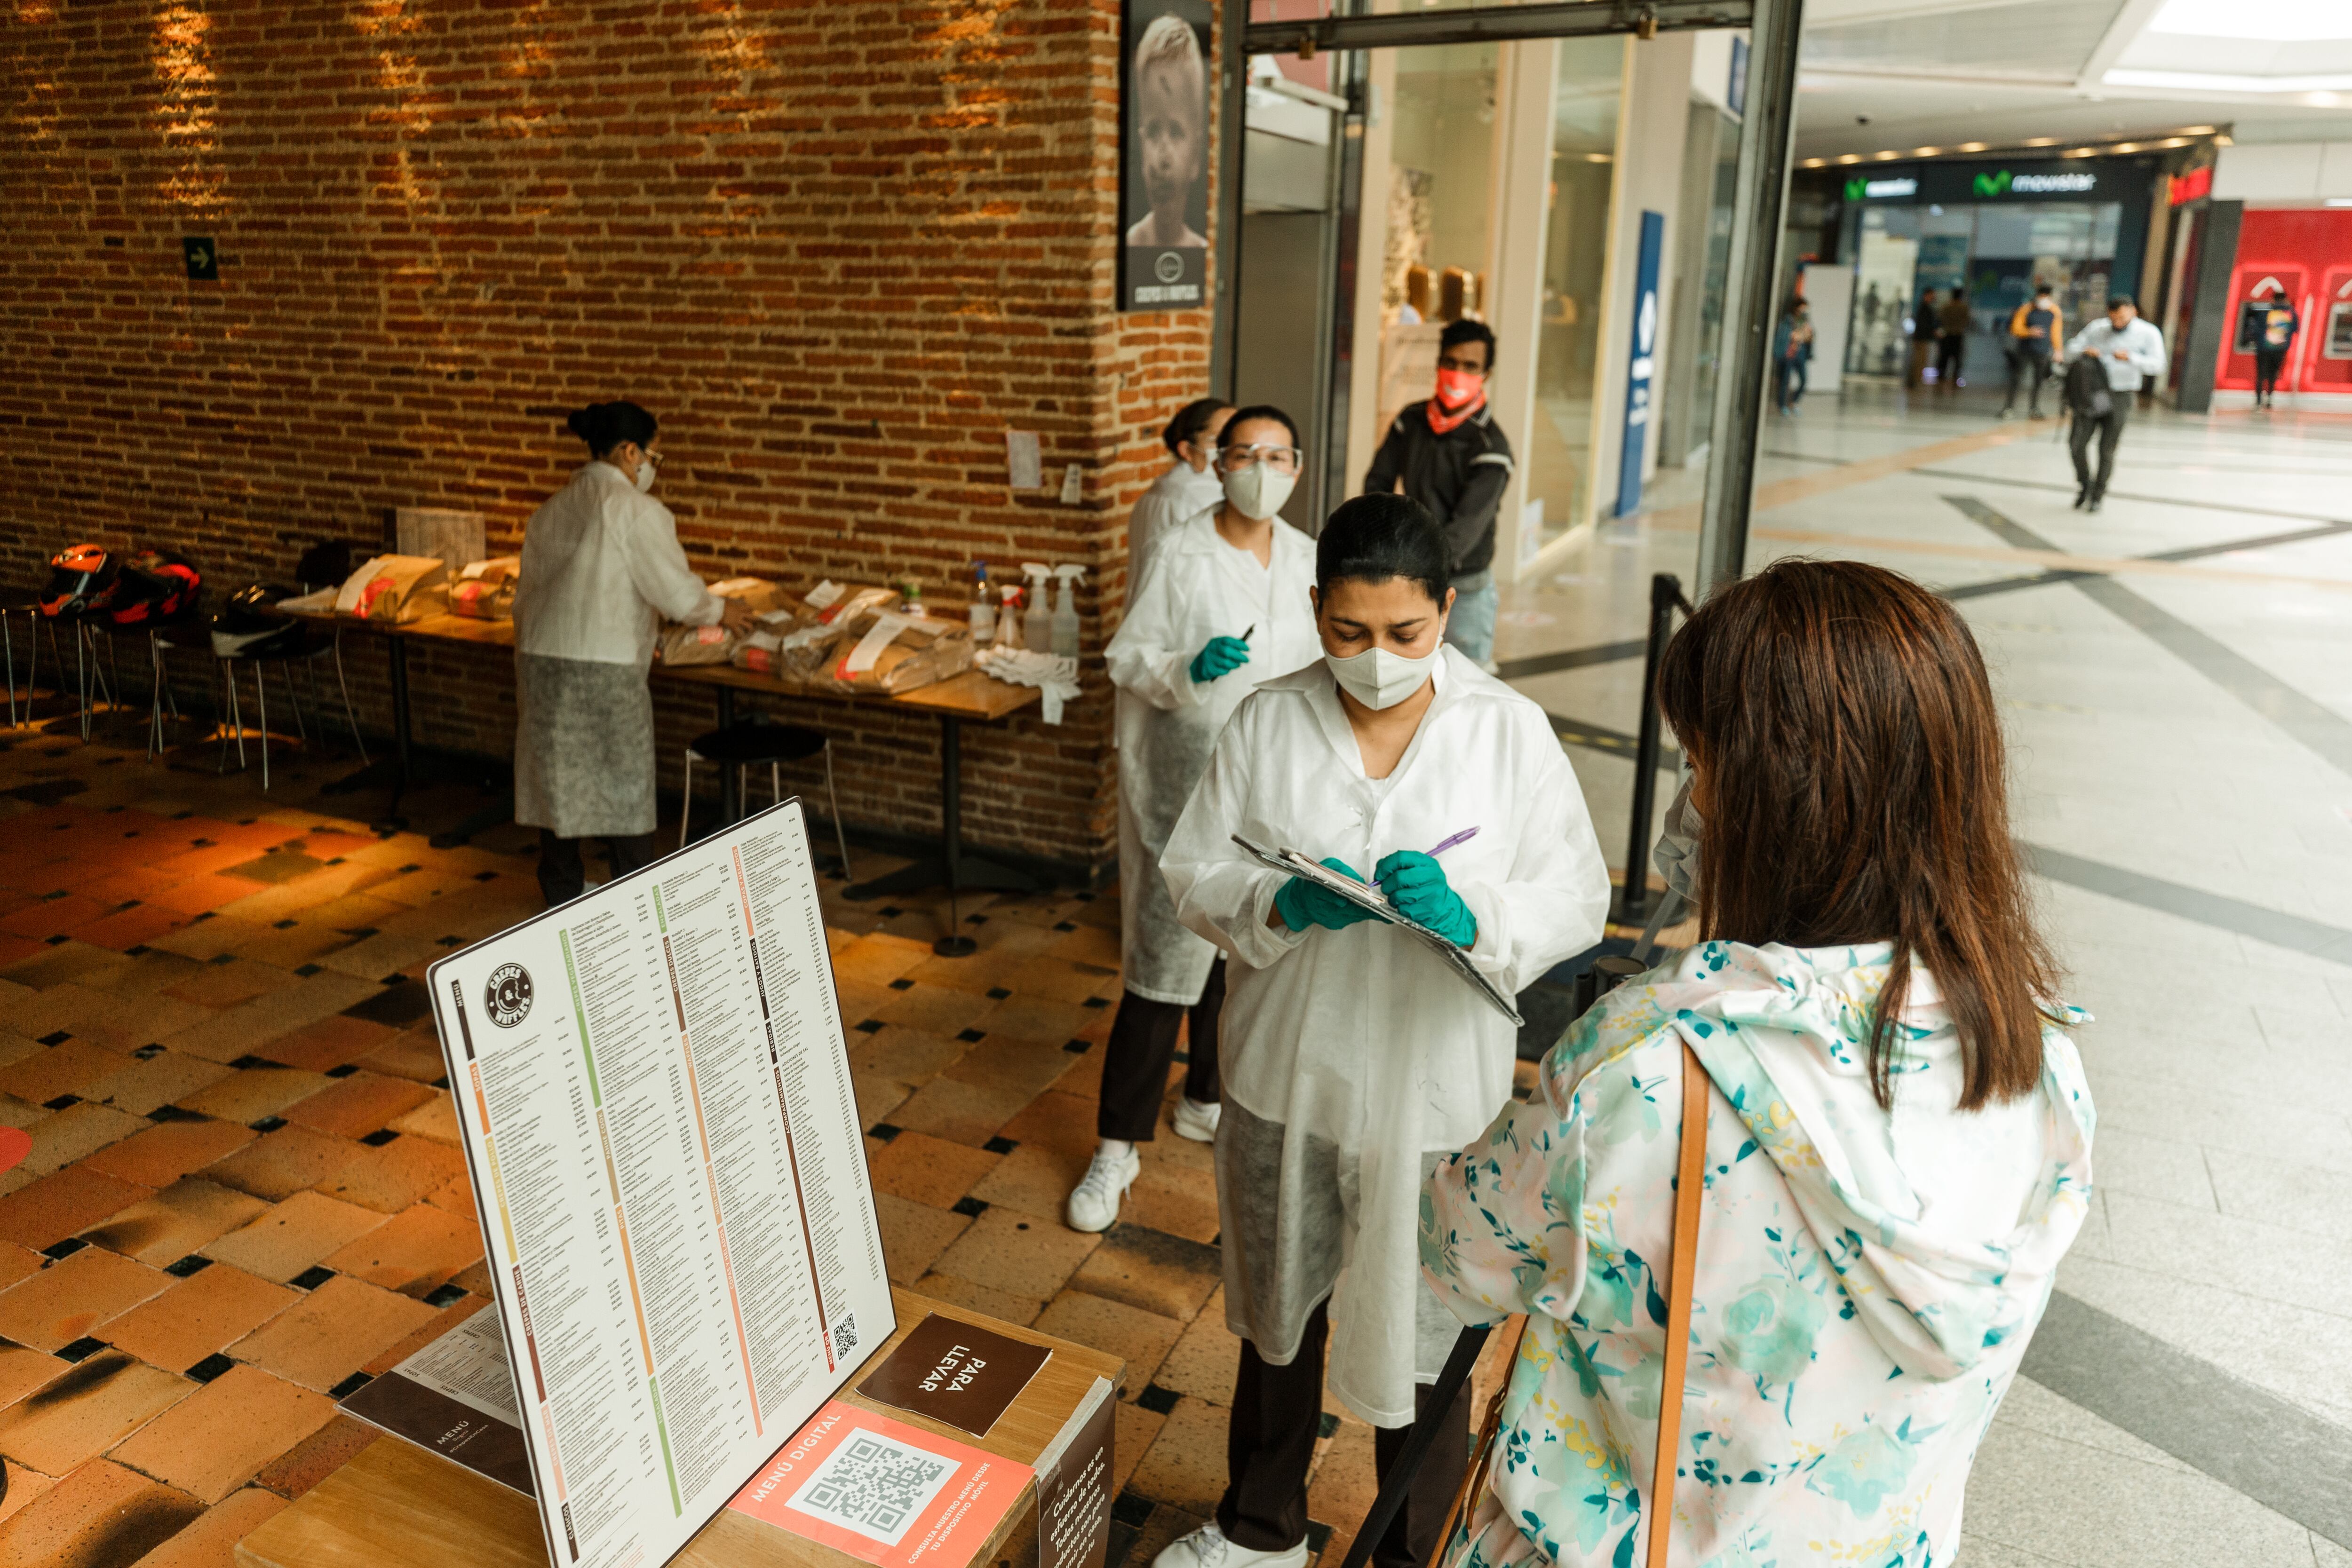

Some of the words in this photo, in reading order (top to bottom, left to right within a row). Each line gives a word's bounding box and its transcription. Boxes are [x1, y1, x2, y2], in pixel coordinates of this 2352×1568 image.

[732, 847, 743, 880] HELADOS
[740, 886, 748, 909] COPAS
[663, 939, 674, 967] DULCES
[751, 941, 760, 970] BATIDOS
[490, 966, 522, 990] CREPES
[669, 966, 679, 993] CREPES
[505, 989, 514, 1001] &
[495, 997, 530, 1024] WAFFLES
[766, 1024, 775, 1053] BEBIDAS
[774, 1069, 790, 1135] ACOMPAÑAMIENTOS
[718, 1227, 729, 1262] HELADOS
[724, 1260, 730, 1269] Y
[726, 1266, 735, 1291] COPAS
[513, 1267, 524, 1297] CARNE
[518, 1294, 527, 1308] DE
[462, 1329, 480, 1338] CREPES
[521, 1306, 533, 1338] CREPES
[824, 1334, 829, 1347] QR
[403, 1368, 421, 1378] SOPAS
[918, 1345, 970, 1392] LLEVAR
[946, 1357, 987, 1391] PARA
[441, 1385, 459, 1395] CREPES
[437, 1420, 469, 1445] MENÚ
[751, 1461, 794, 1503] MENÚ
[789, 1415, 842, 1460] DIGITAL
[1053, 1470, 1087, 1517] Cuidarnos
[1087, 1459, 1094, 1472] es
[1095, 1446, 1104, 1461] un
[908, 1529, 938, 1564] CONSULTA
[934, 1500, 961, 1529] NUESTRO
[957, 1481, 975, 1501] MENÚ
[971, 1462, 991, 1481] DESDE
[930, 1541, 941, 1551] TU
[938, 1502, 972, 1542] DISPOSITIVO
[969, 1481, 989, 1501] MÓVIL
[1050, 1500, 1078, 1542] esfuerzo
[1078, 1488, 1087, 1502] de
[1055, 1523, 1074, 1552] Todos
[1074, 1484, 1100, 1525] nuestros
[1081, 1514, 1091, 1533] son
[1092, 1493, 1105, 1520] para
[1079, 1536, 1087, 1551] en
[1088, 1539, 1095, 1552] tu
